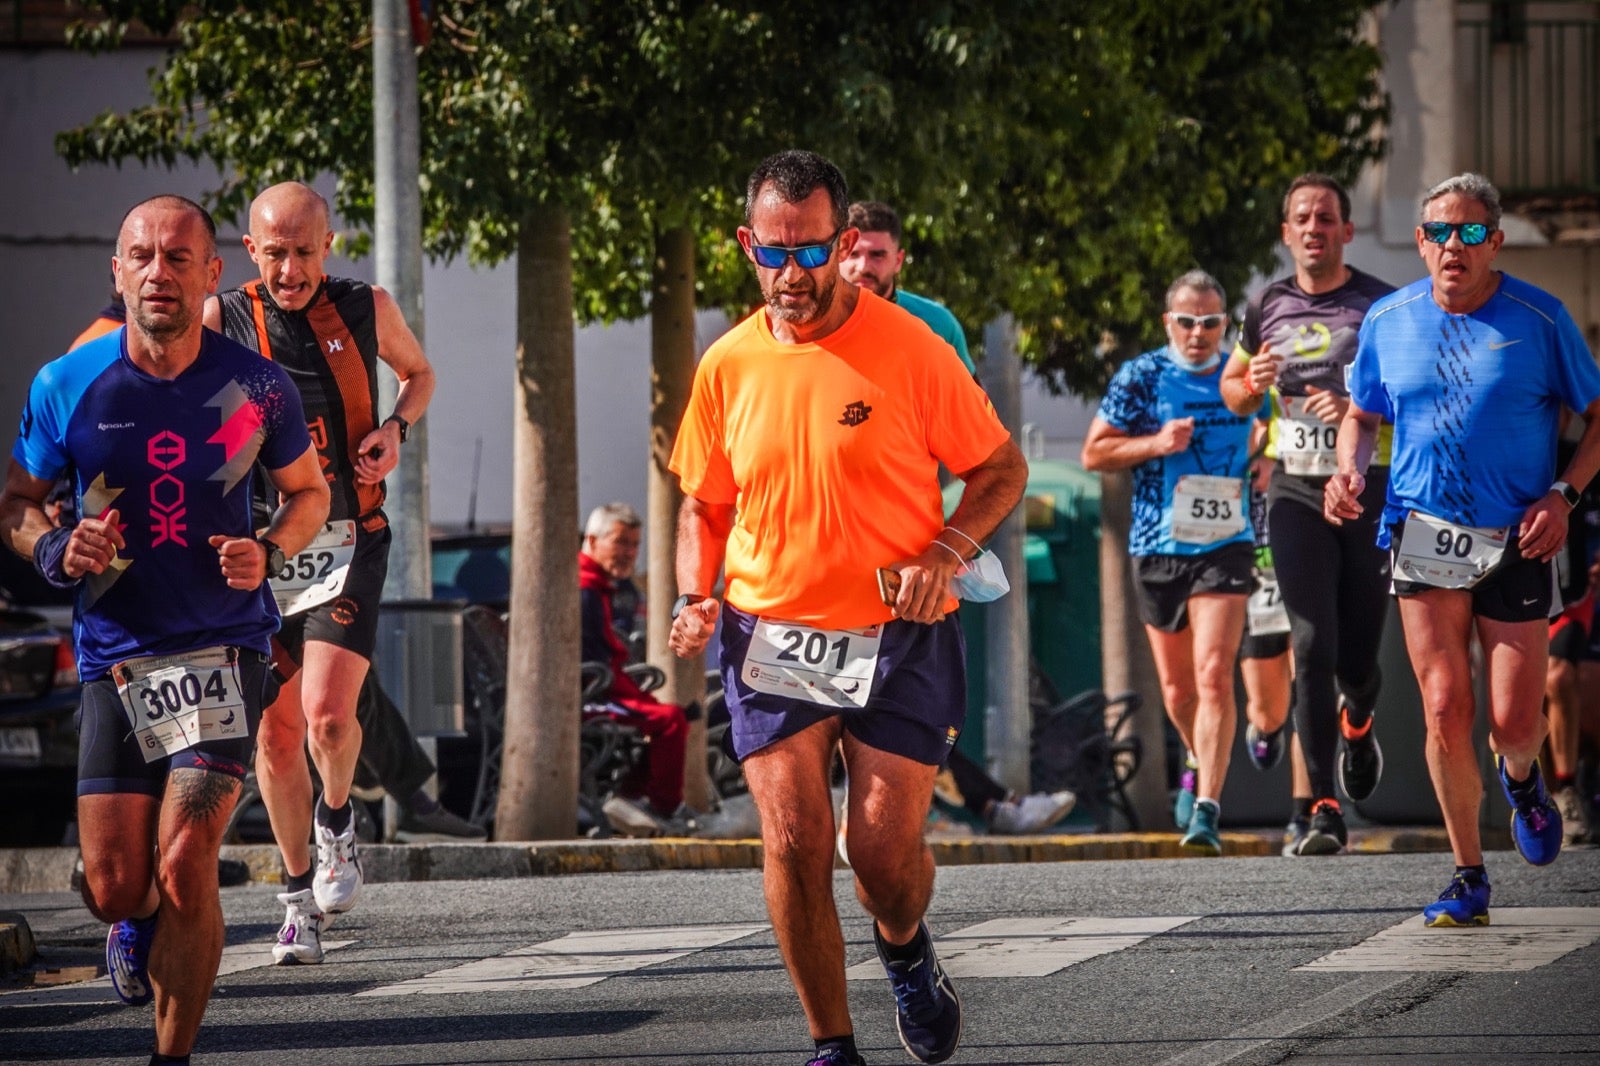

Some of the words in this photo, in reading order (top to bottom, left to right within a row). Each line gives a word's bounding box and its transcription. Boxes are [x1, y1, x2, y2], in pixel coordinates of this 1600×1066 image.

[1295, 427, 1337, 449] 310
[1191, 498, 1232, 520] 533
[1435, 529, 1473, 558] 90
[776, 630, 850, 671] 201
[140, 670, 228, 720] 3004
